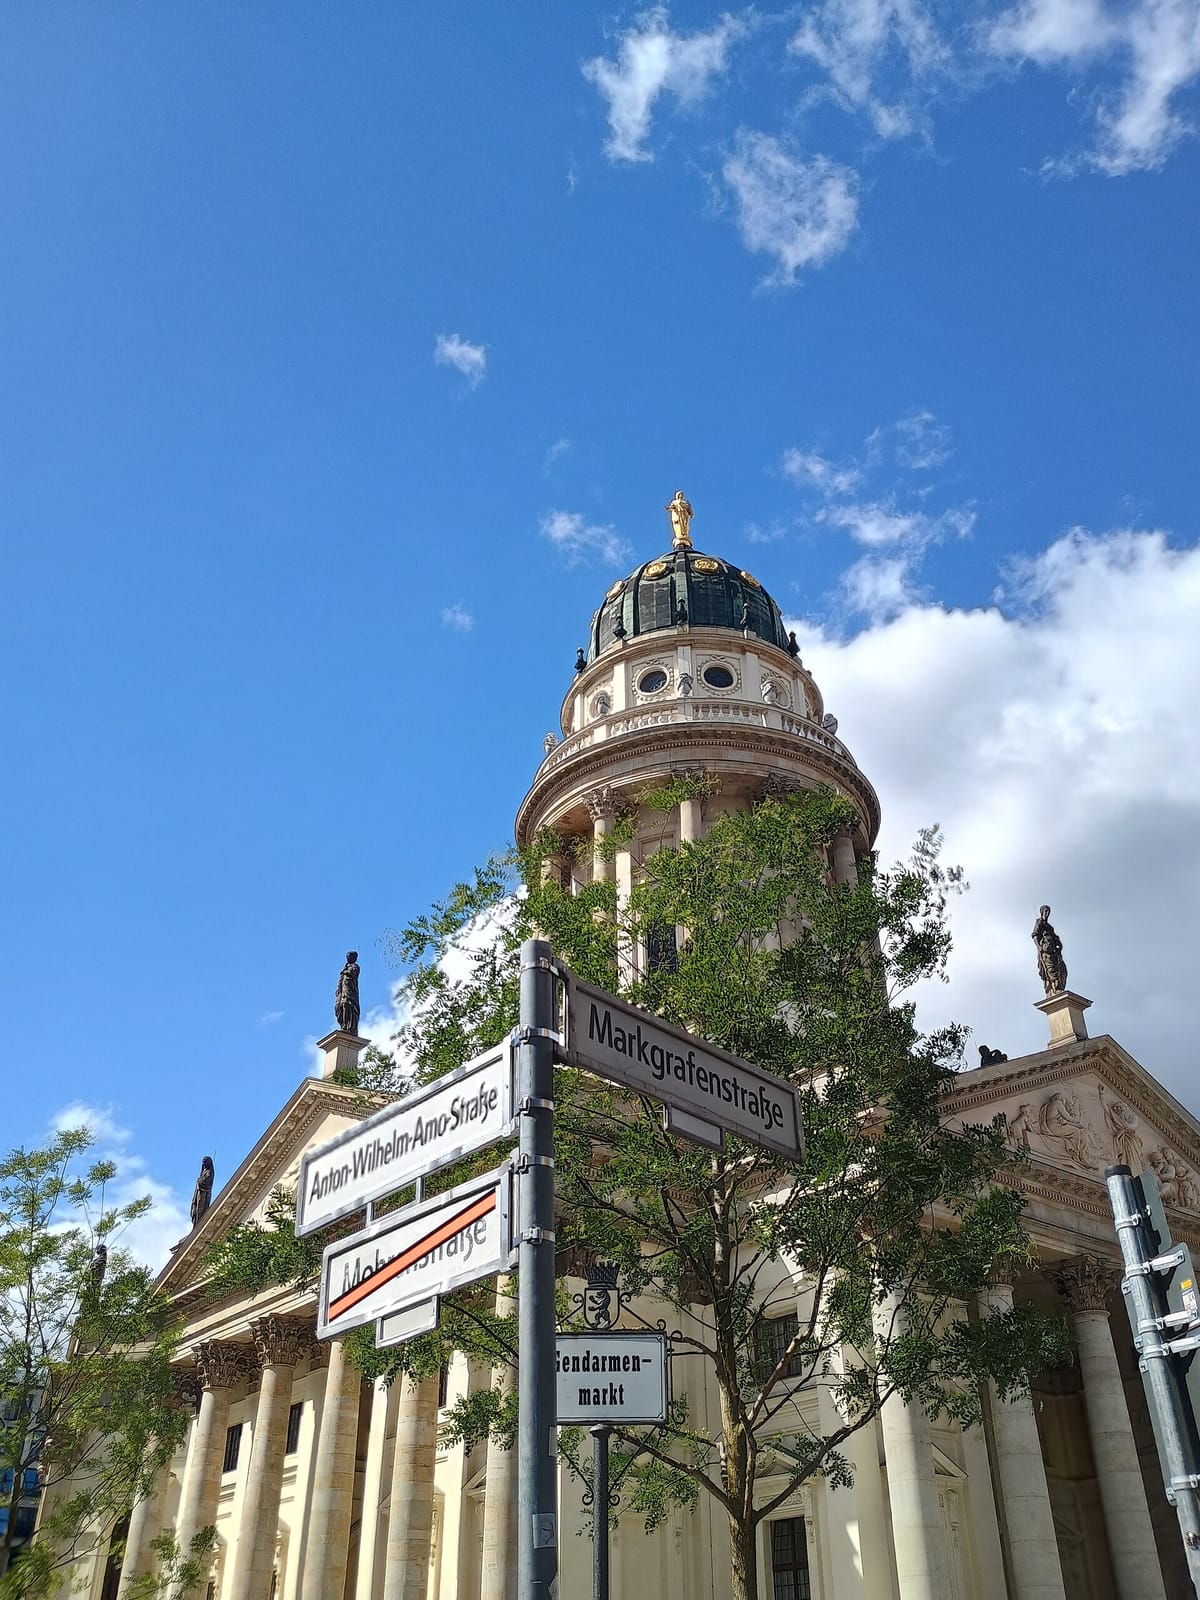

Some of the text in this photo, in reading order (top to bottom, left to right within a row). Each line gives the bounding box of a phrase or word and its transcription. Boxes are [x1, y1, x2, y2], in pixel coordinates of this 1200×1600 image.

[588, 1002, 784, 1130] Markgrafenstraße
[309, 1080, 499, 1205] Anton-Wilhelm-Amo-Straße
[342, 1217, 487, 1295] Mohsaße
[578, 1382, 625, 1406] markt
